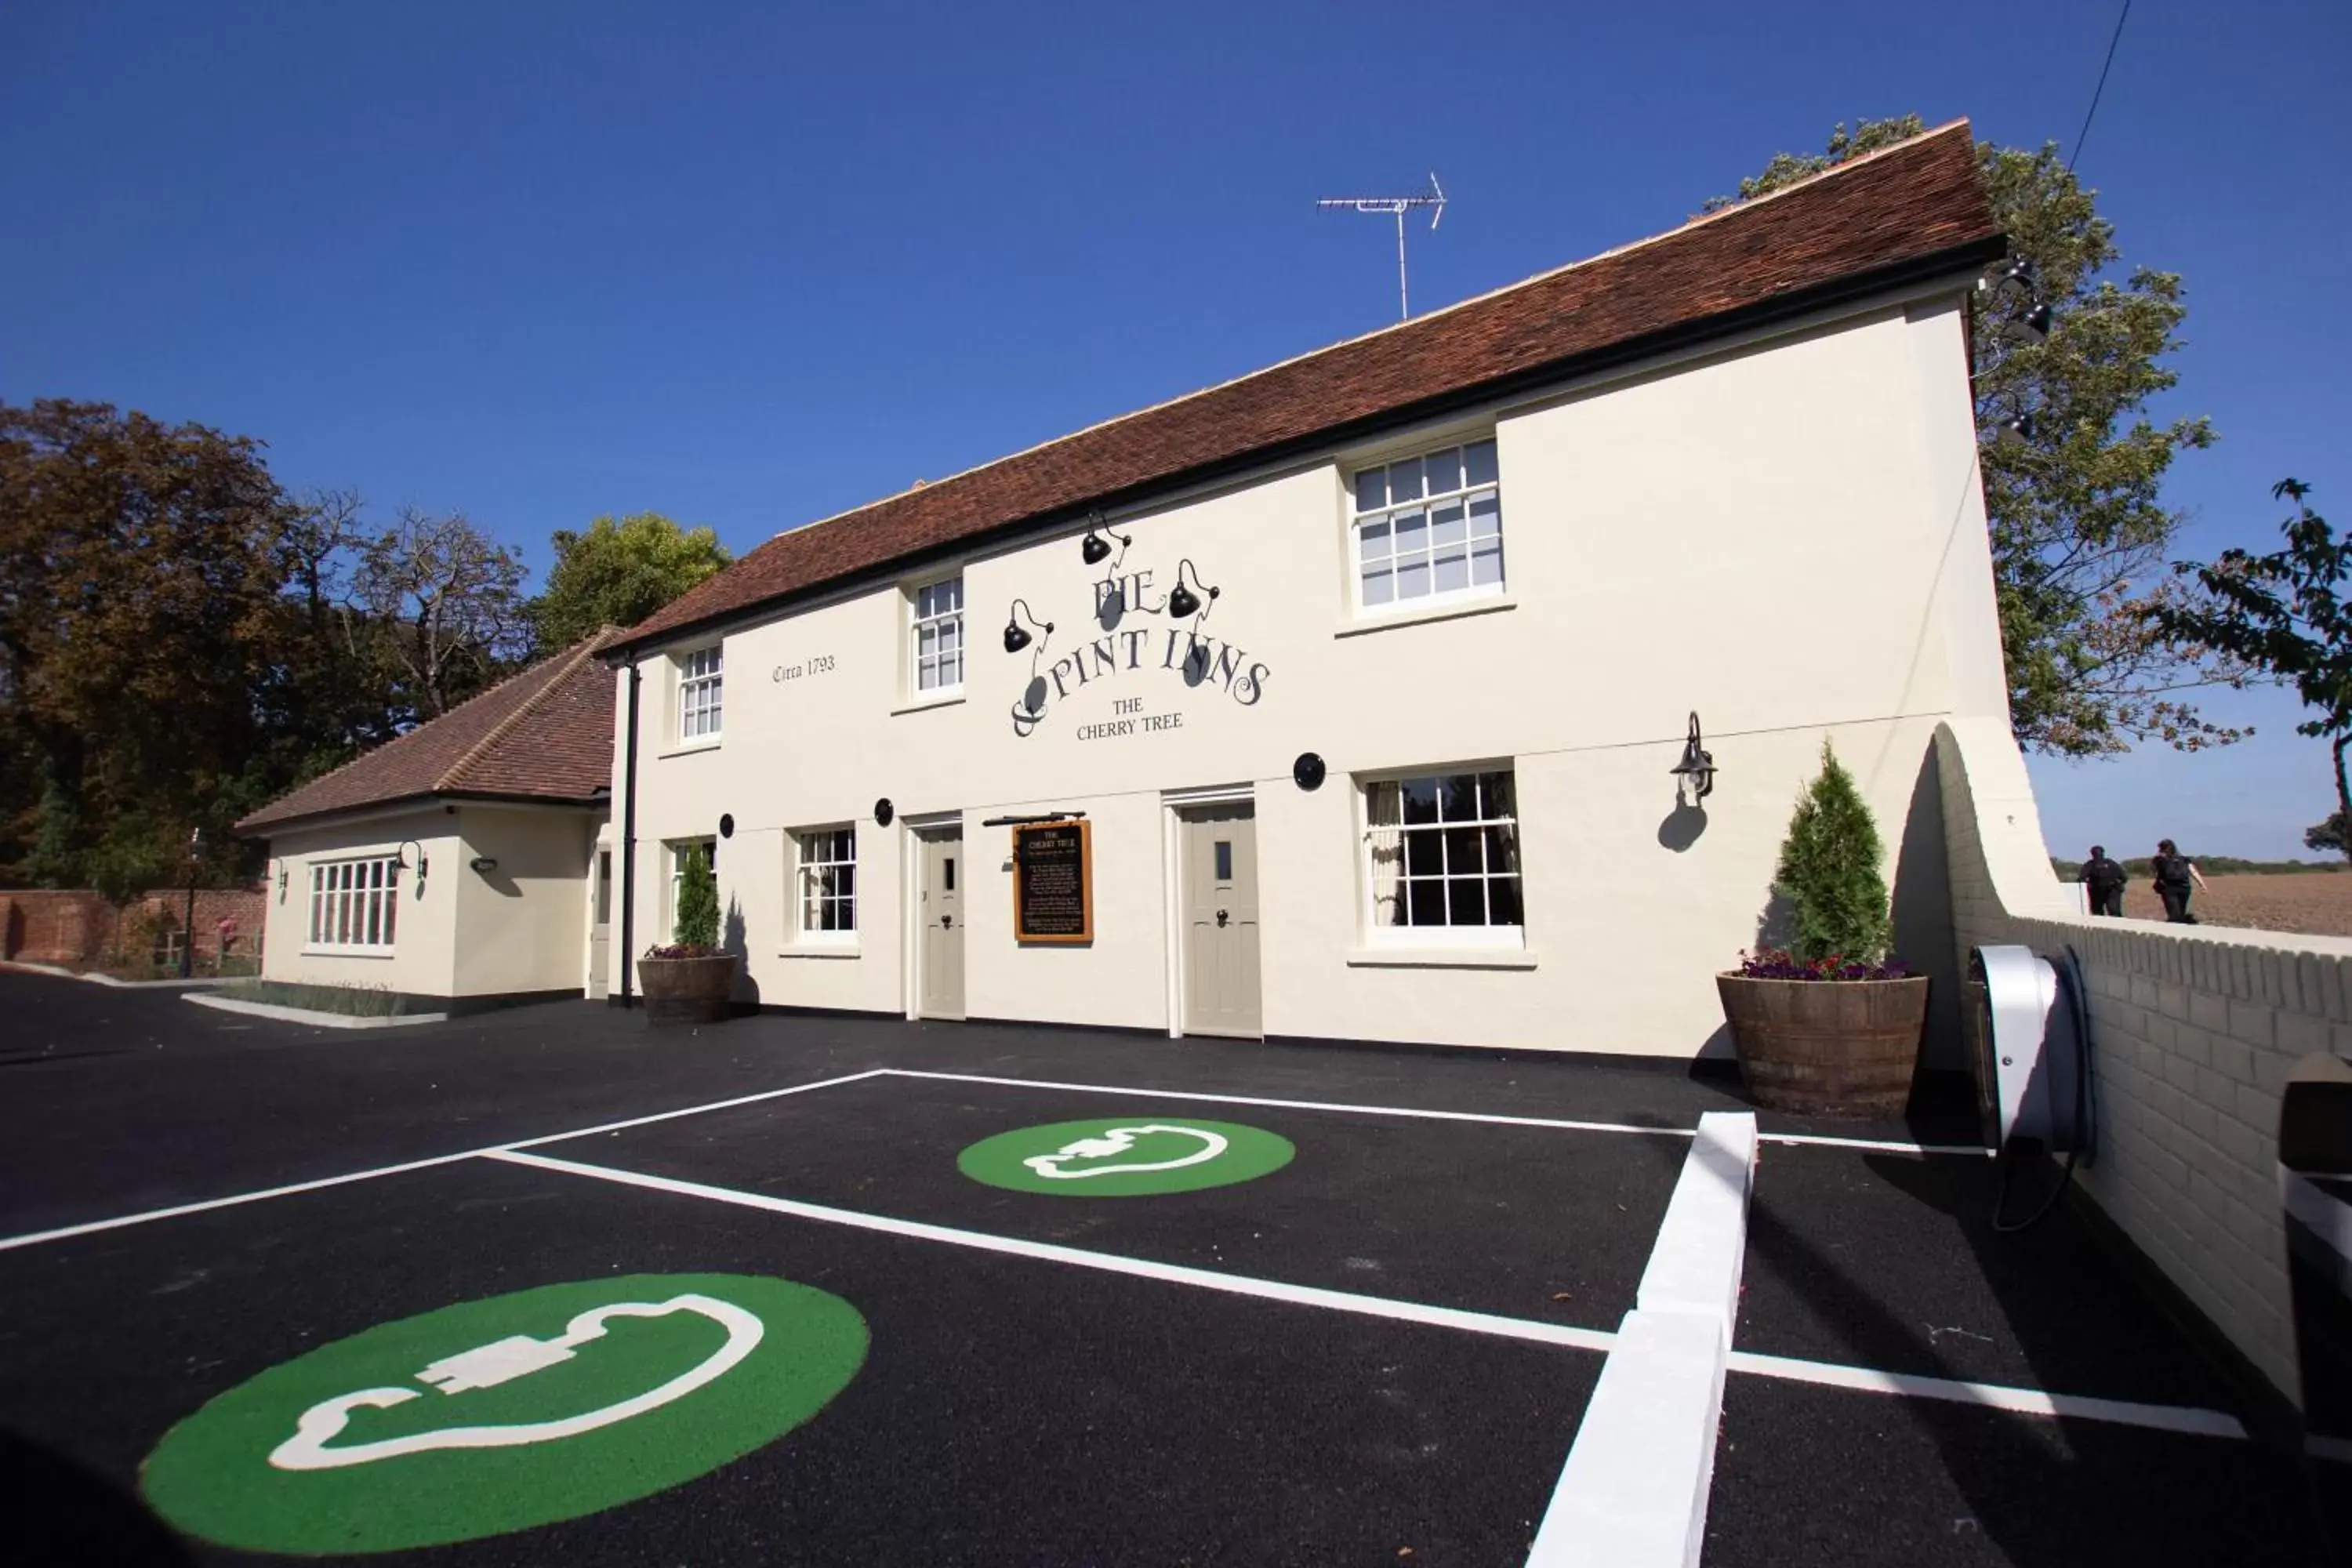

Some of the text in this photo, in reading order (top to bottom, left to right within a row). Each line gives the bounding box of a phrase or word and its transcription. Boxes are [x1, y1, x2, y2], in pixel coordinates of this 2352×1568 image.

[1091, 568, 1167, 620] PIE
[772, 655, 835, 683] Circa 1793
[1048, 629, 1149, 702] PINT
[1160, 629, 1271, 706] INNS
[1112, 697, 1144, 716] THE
[1076, 713, 1183, 741] CHERRY TREE
